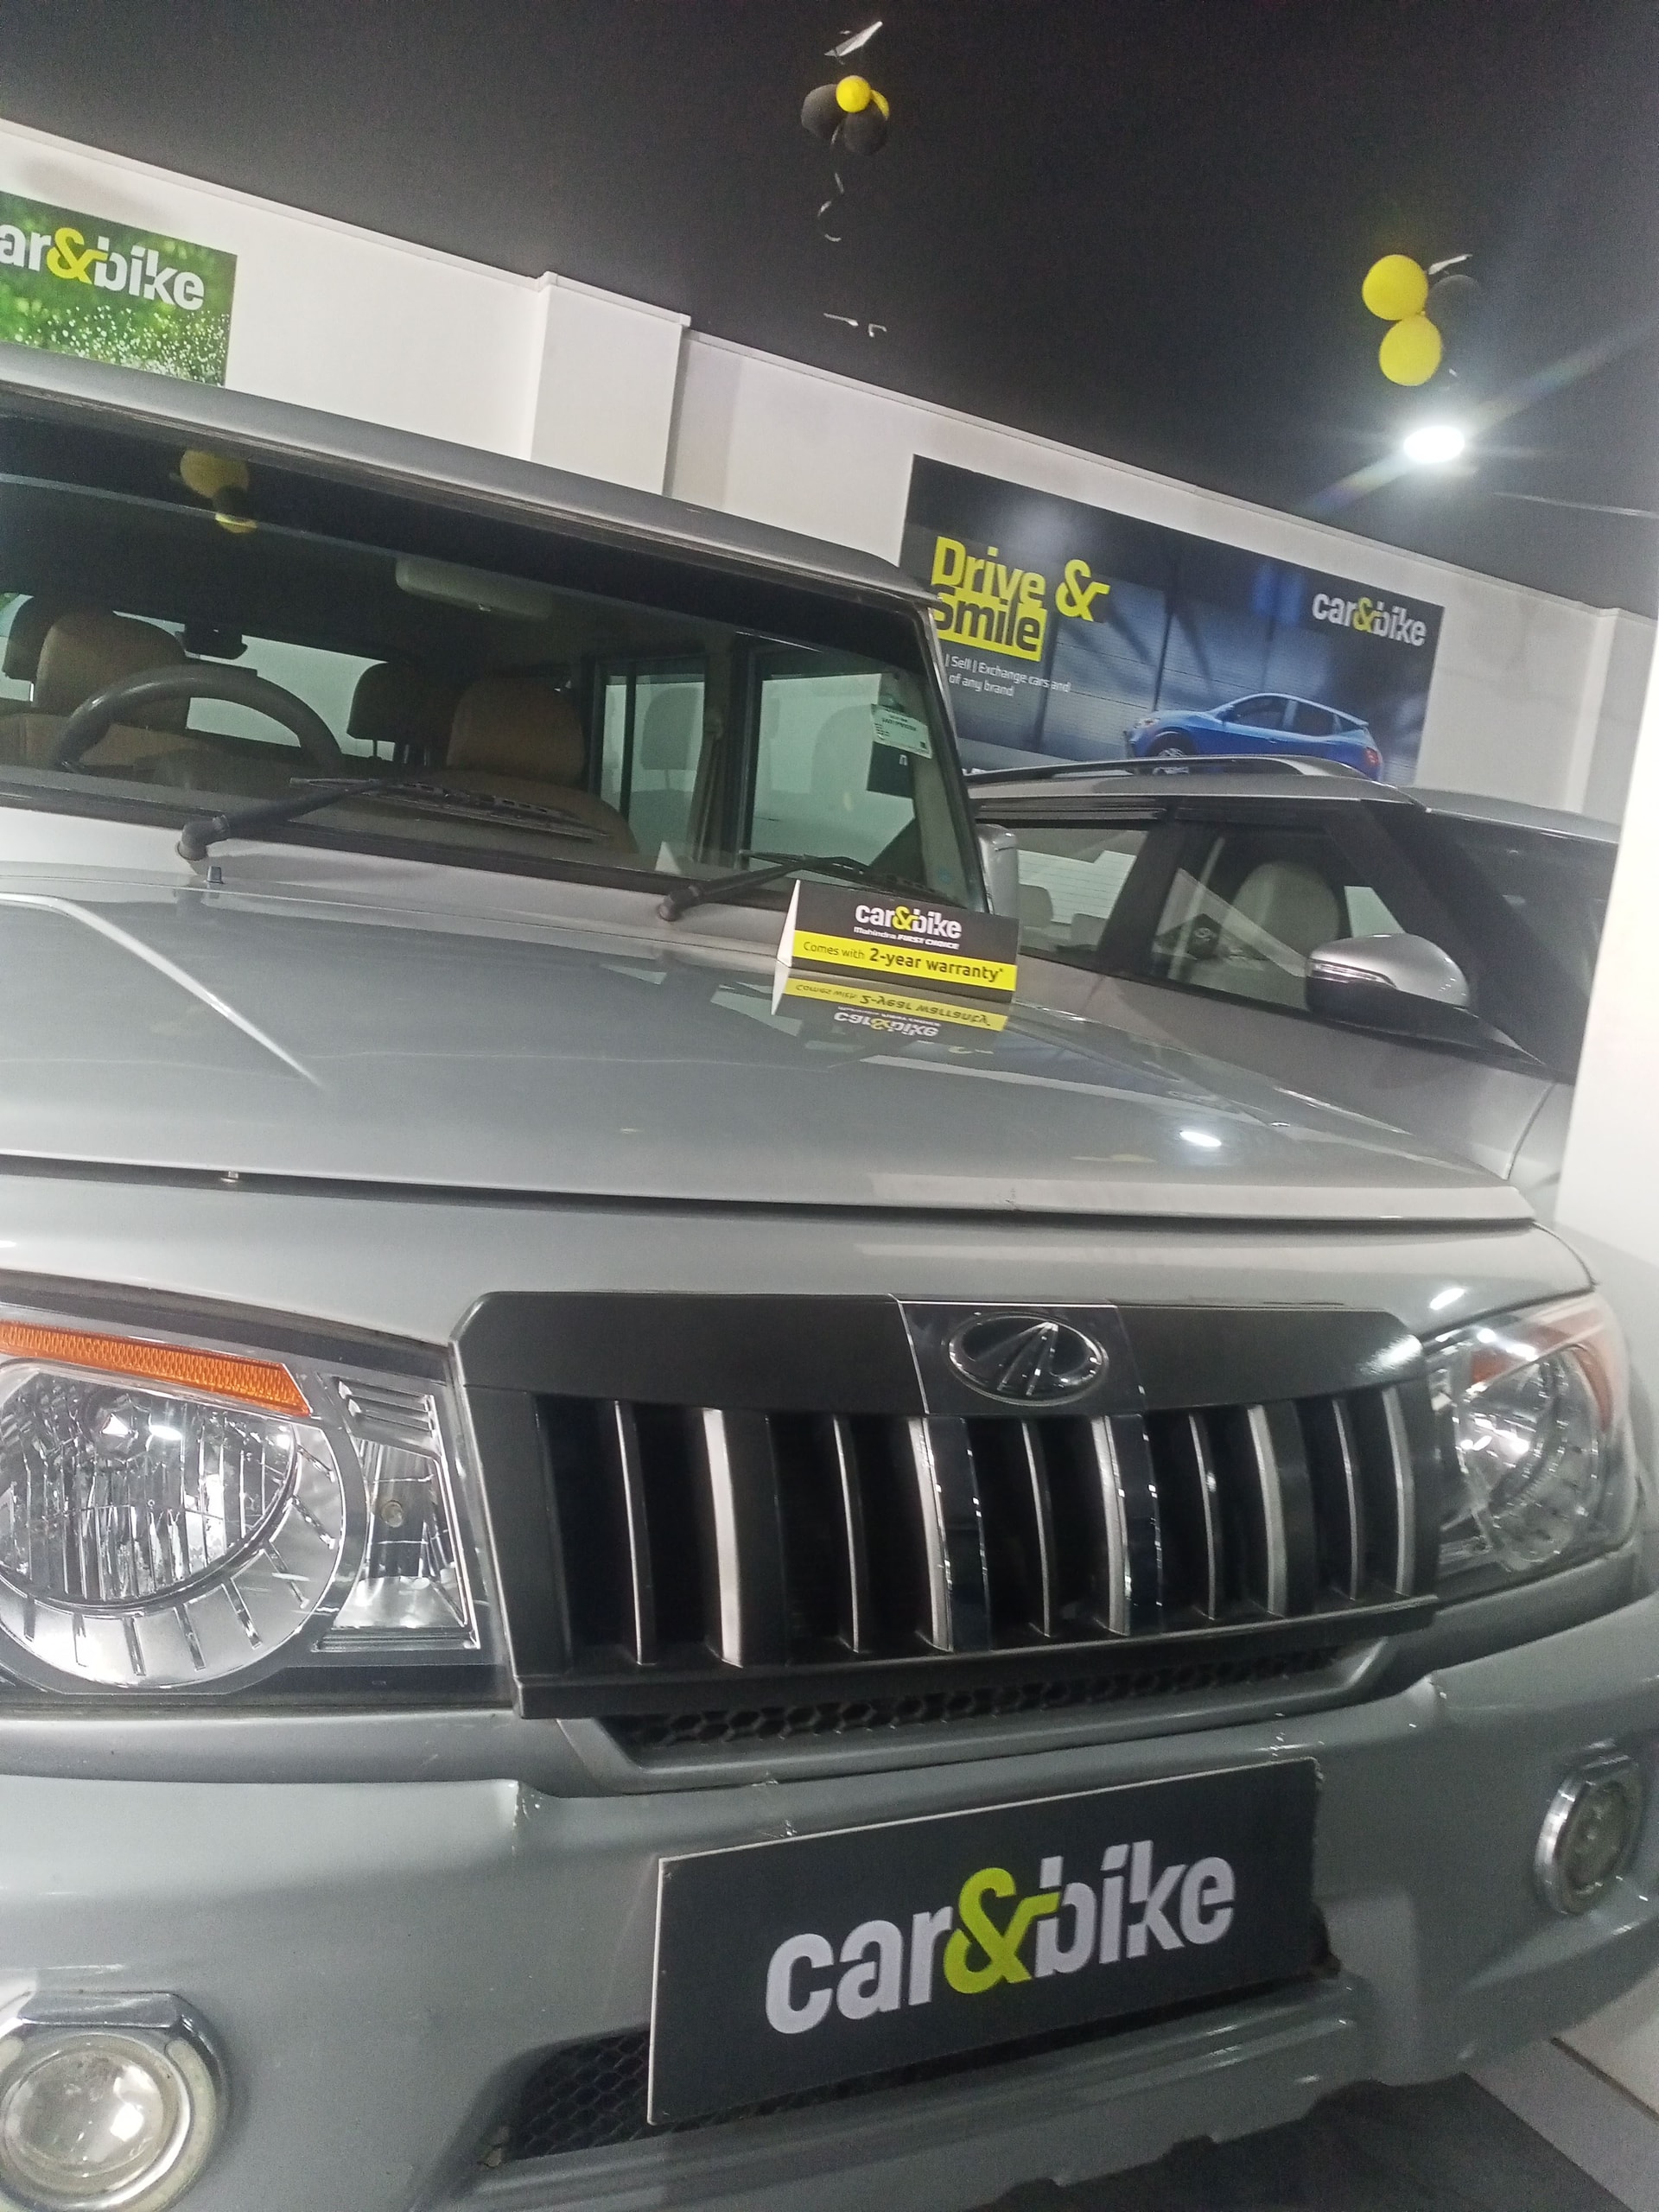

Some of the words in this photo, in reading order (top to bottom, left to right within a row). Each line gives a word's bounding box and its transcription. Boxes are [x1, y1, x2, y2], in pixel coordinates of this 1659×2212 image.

[0, 224, 205, 310] ar&bike
[931, 536, 1046, 608] Drive
[1055, 559, 1110, 622] &
[932, 584, 1040, 652] Smile
[1312, 594, 1427, 646] car&bike
[949, 673, 961, 685] of
[962, 677, 983, 692] any
[983, 679, 1015, 696] brand
[951, 656, 972, 671] Sell
[978, 662, 1028, 684] Exchange
[1028, 676, 1050, 689] cars
[1051, 681, 1072, 693] and
[855, 905, 963, 939] car&bike
[898, 934, 925, 944] FIRST
[925, 938, 960, 950] CHOICE
[803, 941, 839, 957] Comes
[842, 945, 865, 960] with
[869, 947, 921, 969] 2-year
[765, 1839, 1237, 2035] car&bike
